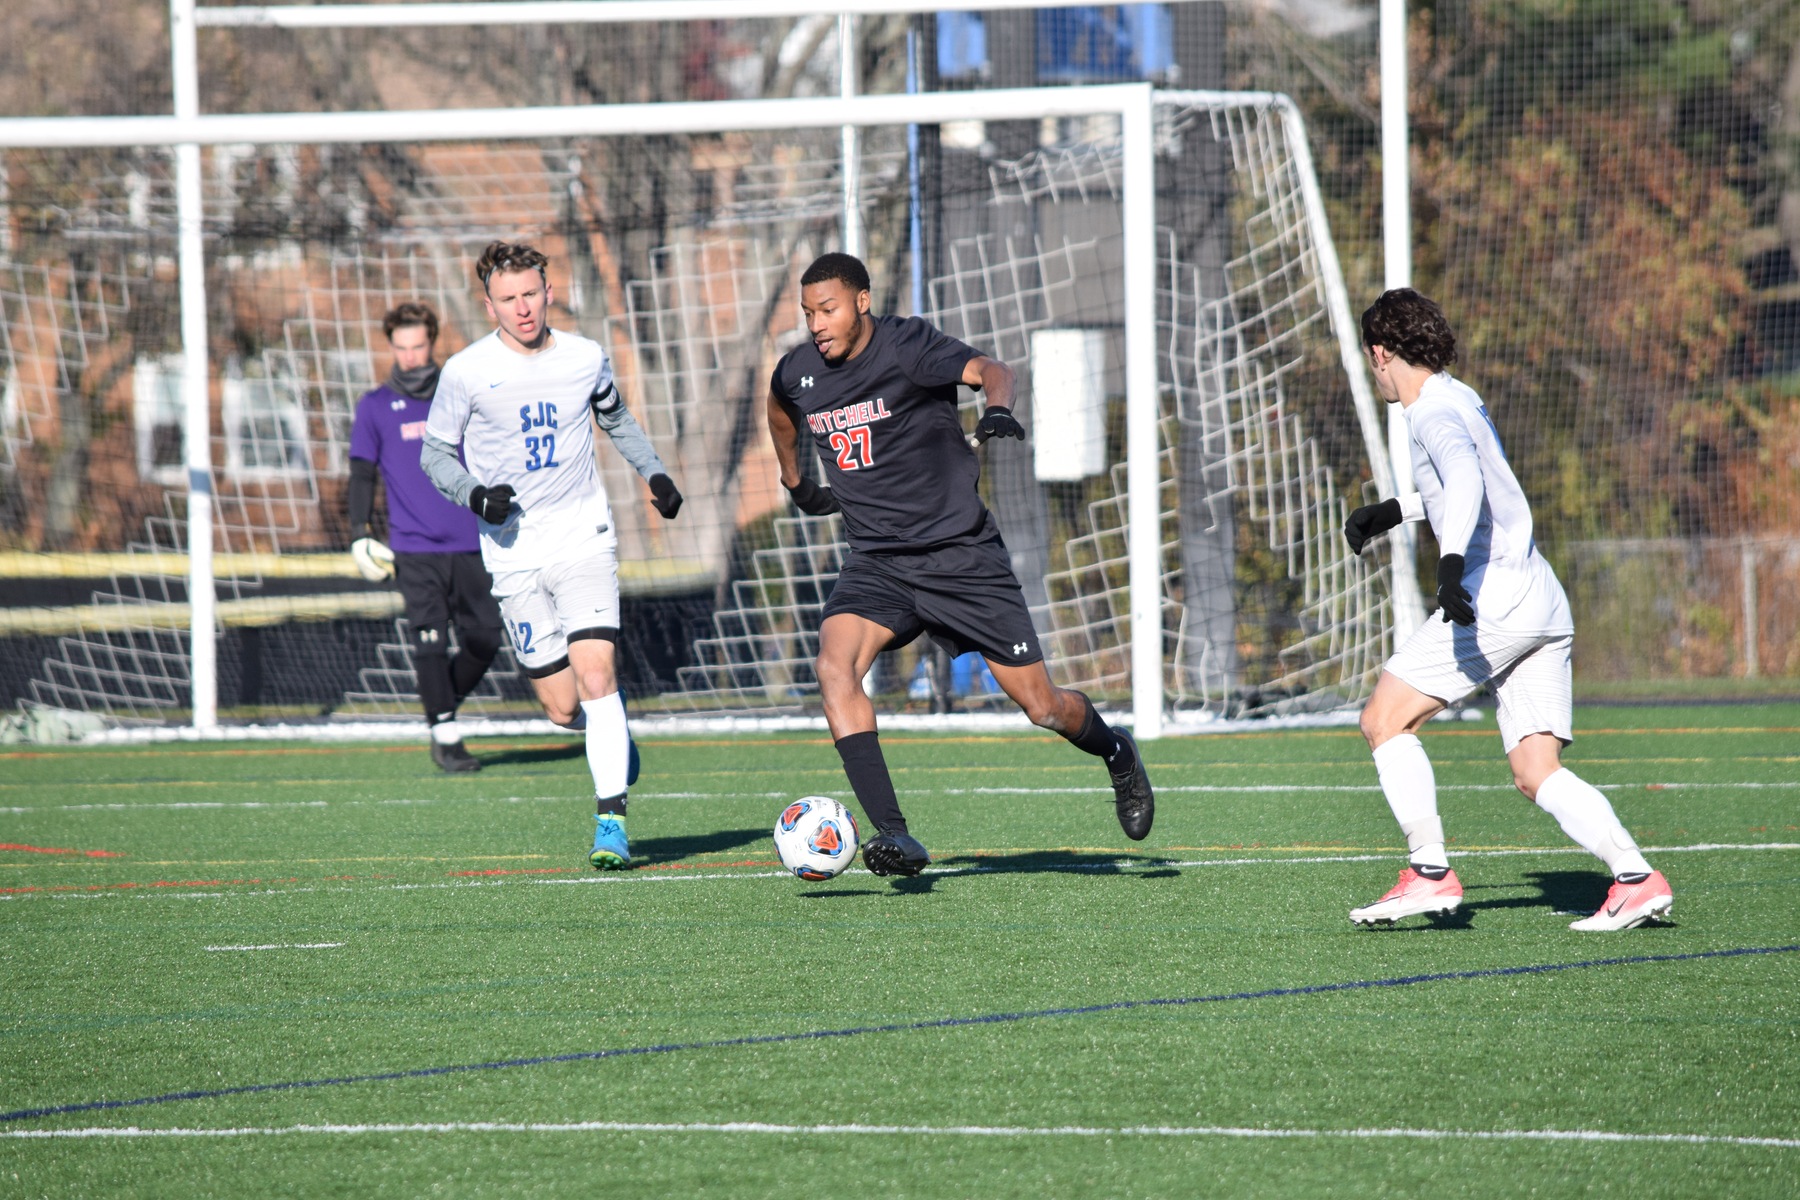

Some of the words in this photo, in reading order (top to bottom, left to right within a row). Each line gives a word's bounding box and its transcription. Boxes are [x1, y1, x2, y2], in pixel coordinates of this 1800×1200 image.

[520, 401, 558, 433] SJC
[806, 398, 891, 434] MITCHELL
[525, 433, 559, 471] 32
[829, 425, 874, 471] 27
